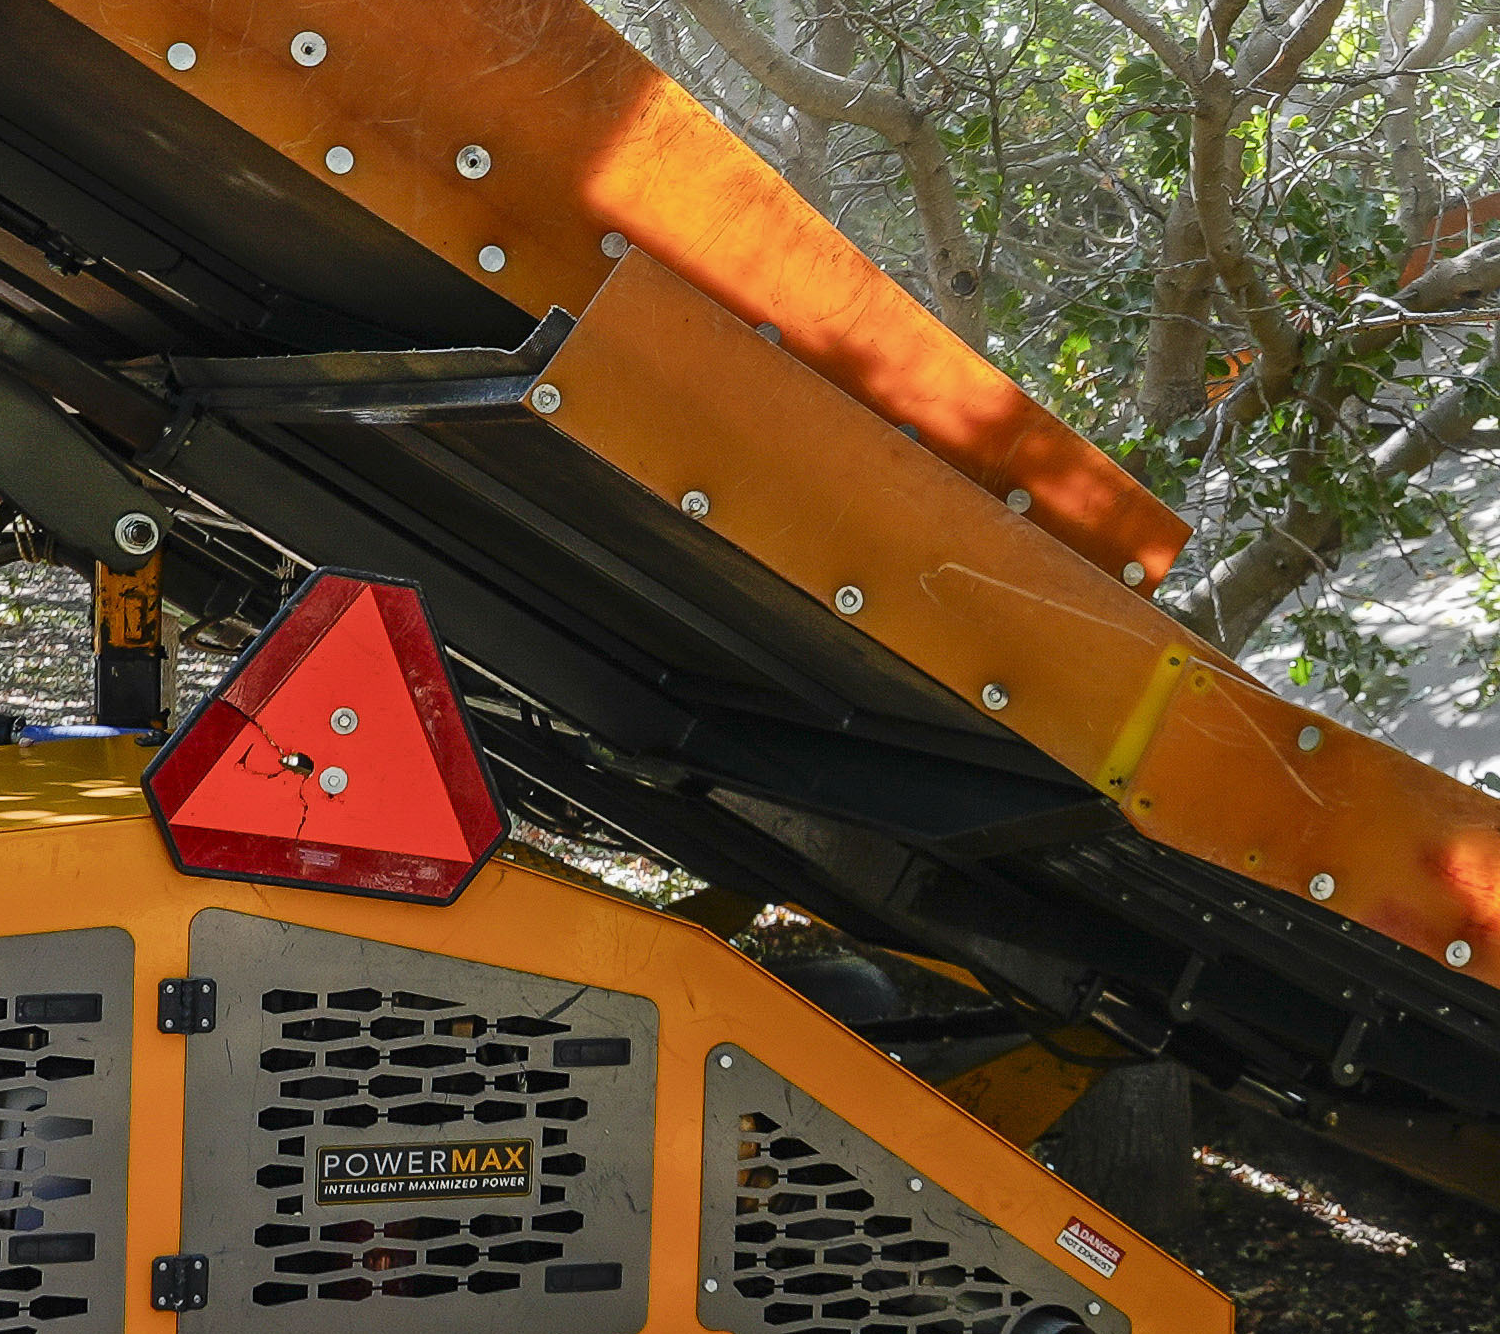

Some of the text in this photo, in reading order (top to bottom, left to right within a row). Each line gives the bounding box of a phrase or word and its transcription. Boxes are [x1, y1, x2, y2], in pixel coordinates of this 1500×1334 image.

[324, 1146, 525, 1178] POWERMAX
[324, 1176, 525, 1195] INTELLIGENT MAXIMIZED POWER
[1061, 1234, 1113, 1272] HOT EXHAUST
[1079, 1228, 1120, 1263] DANGER
